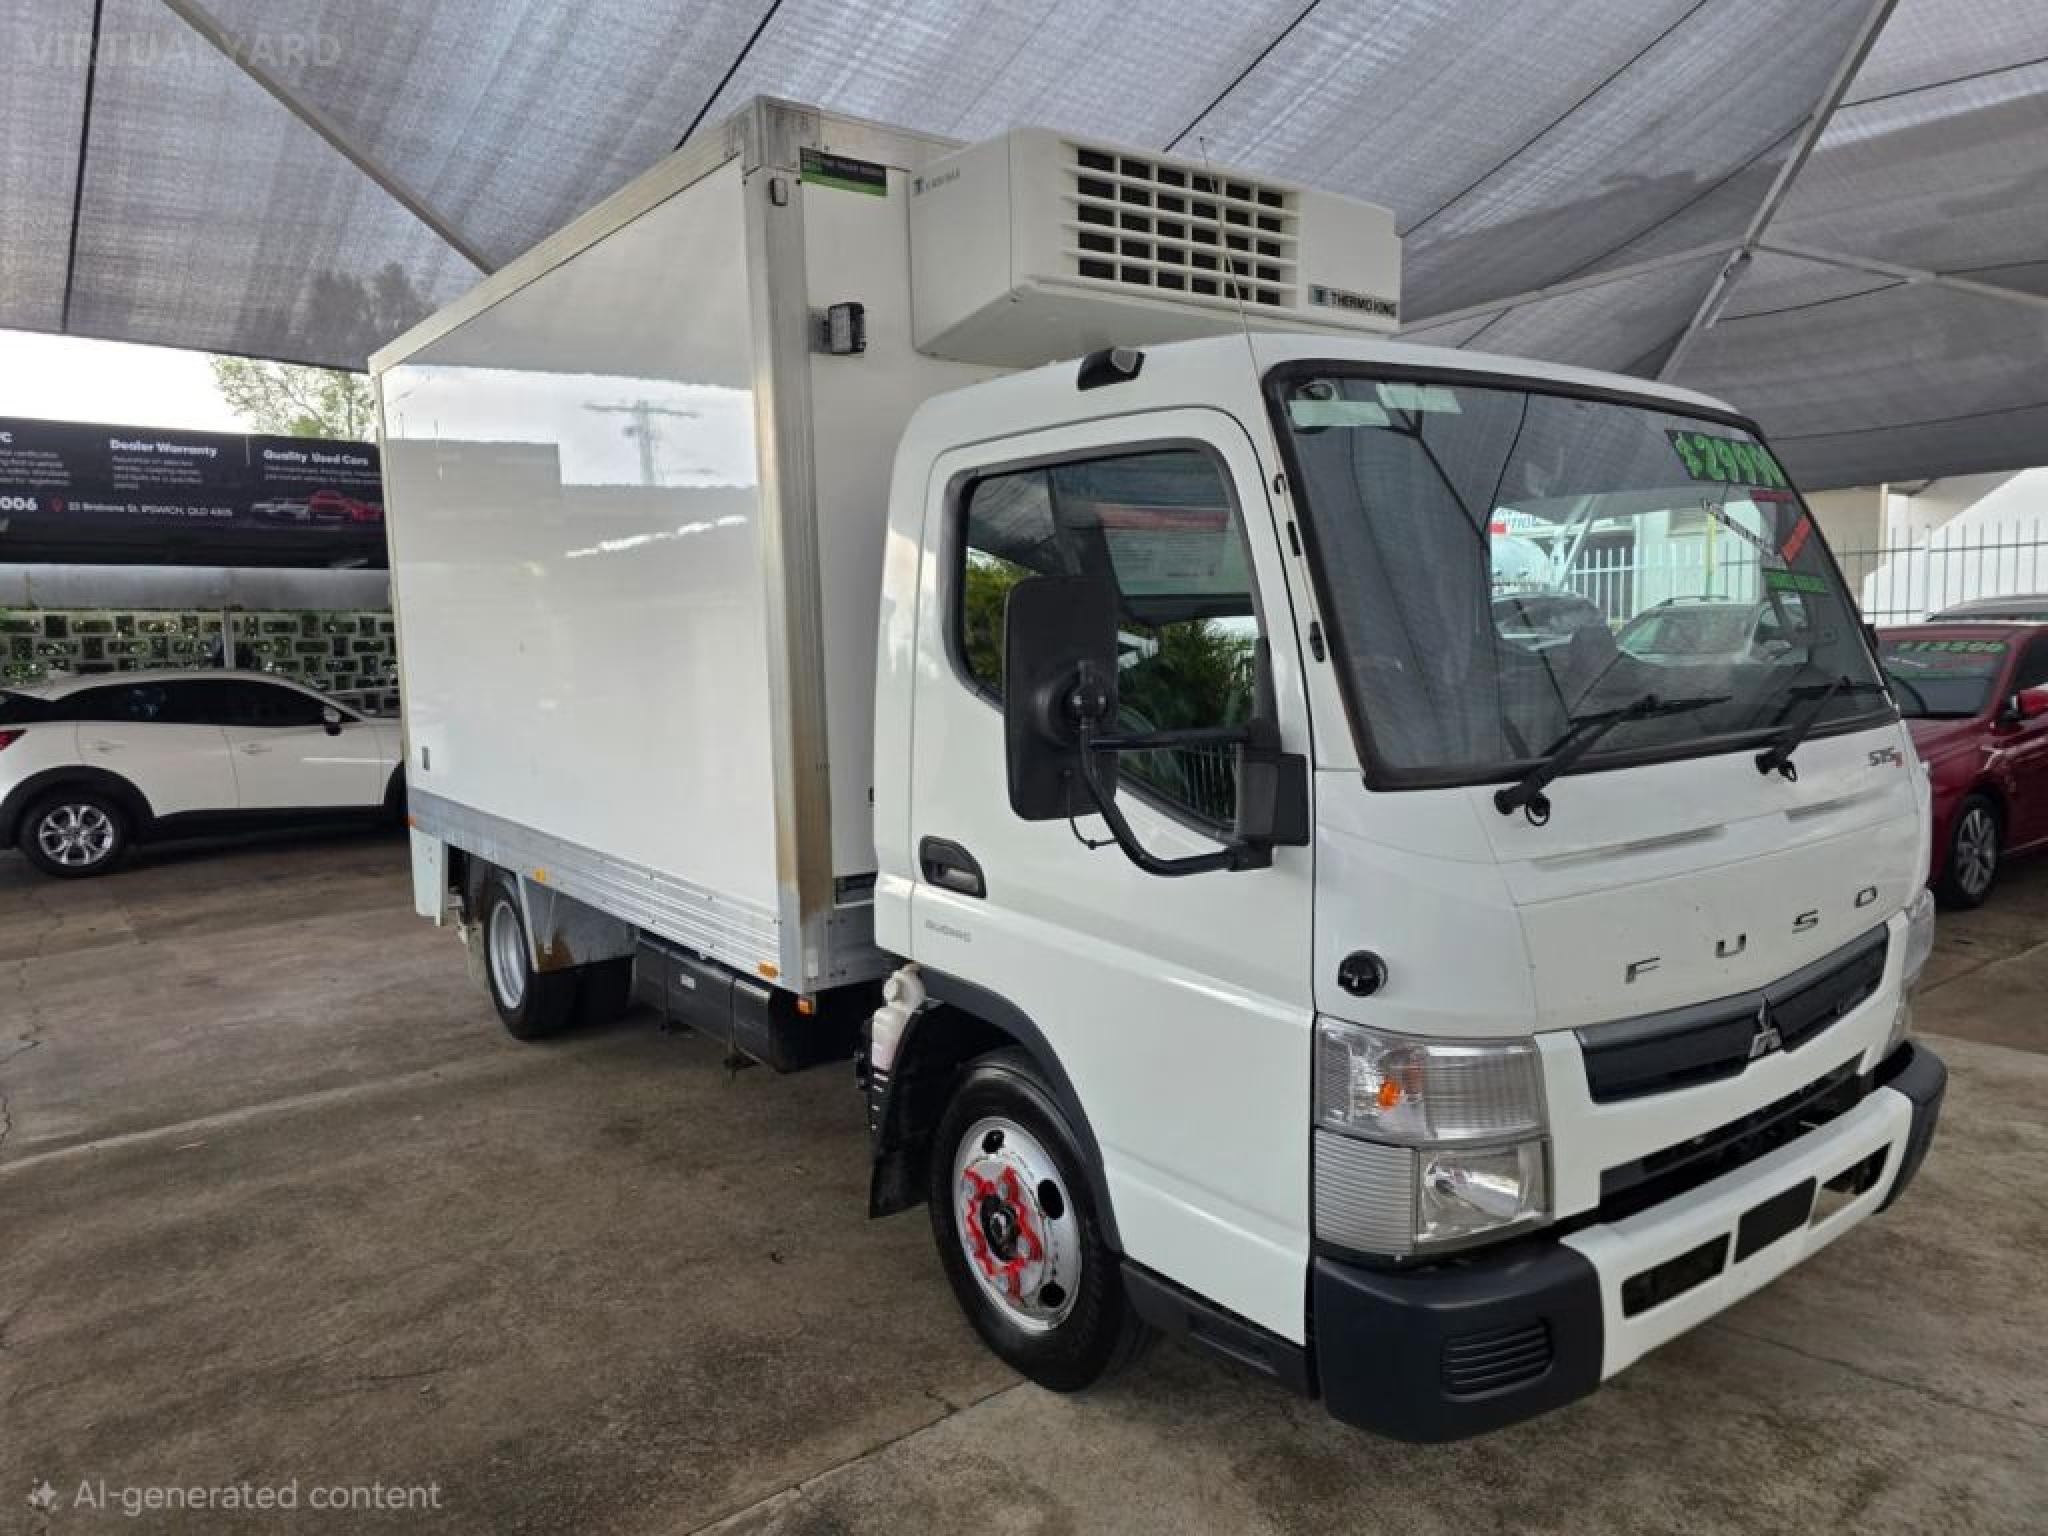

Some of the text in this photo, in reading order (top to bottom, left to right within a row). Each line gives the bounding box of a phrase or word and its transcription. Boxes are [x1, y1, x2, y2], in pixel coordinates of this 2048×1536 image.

[1331, 289, 1373, 313] THERMO
[110, 439, 218, 458] Dealer Warranty
[263, 449, 369, 466] Quality Used Cars
[1624, 885, 1879, 985] FUSO
